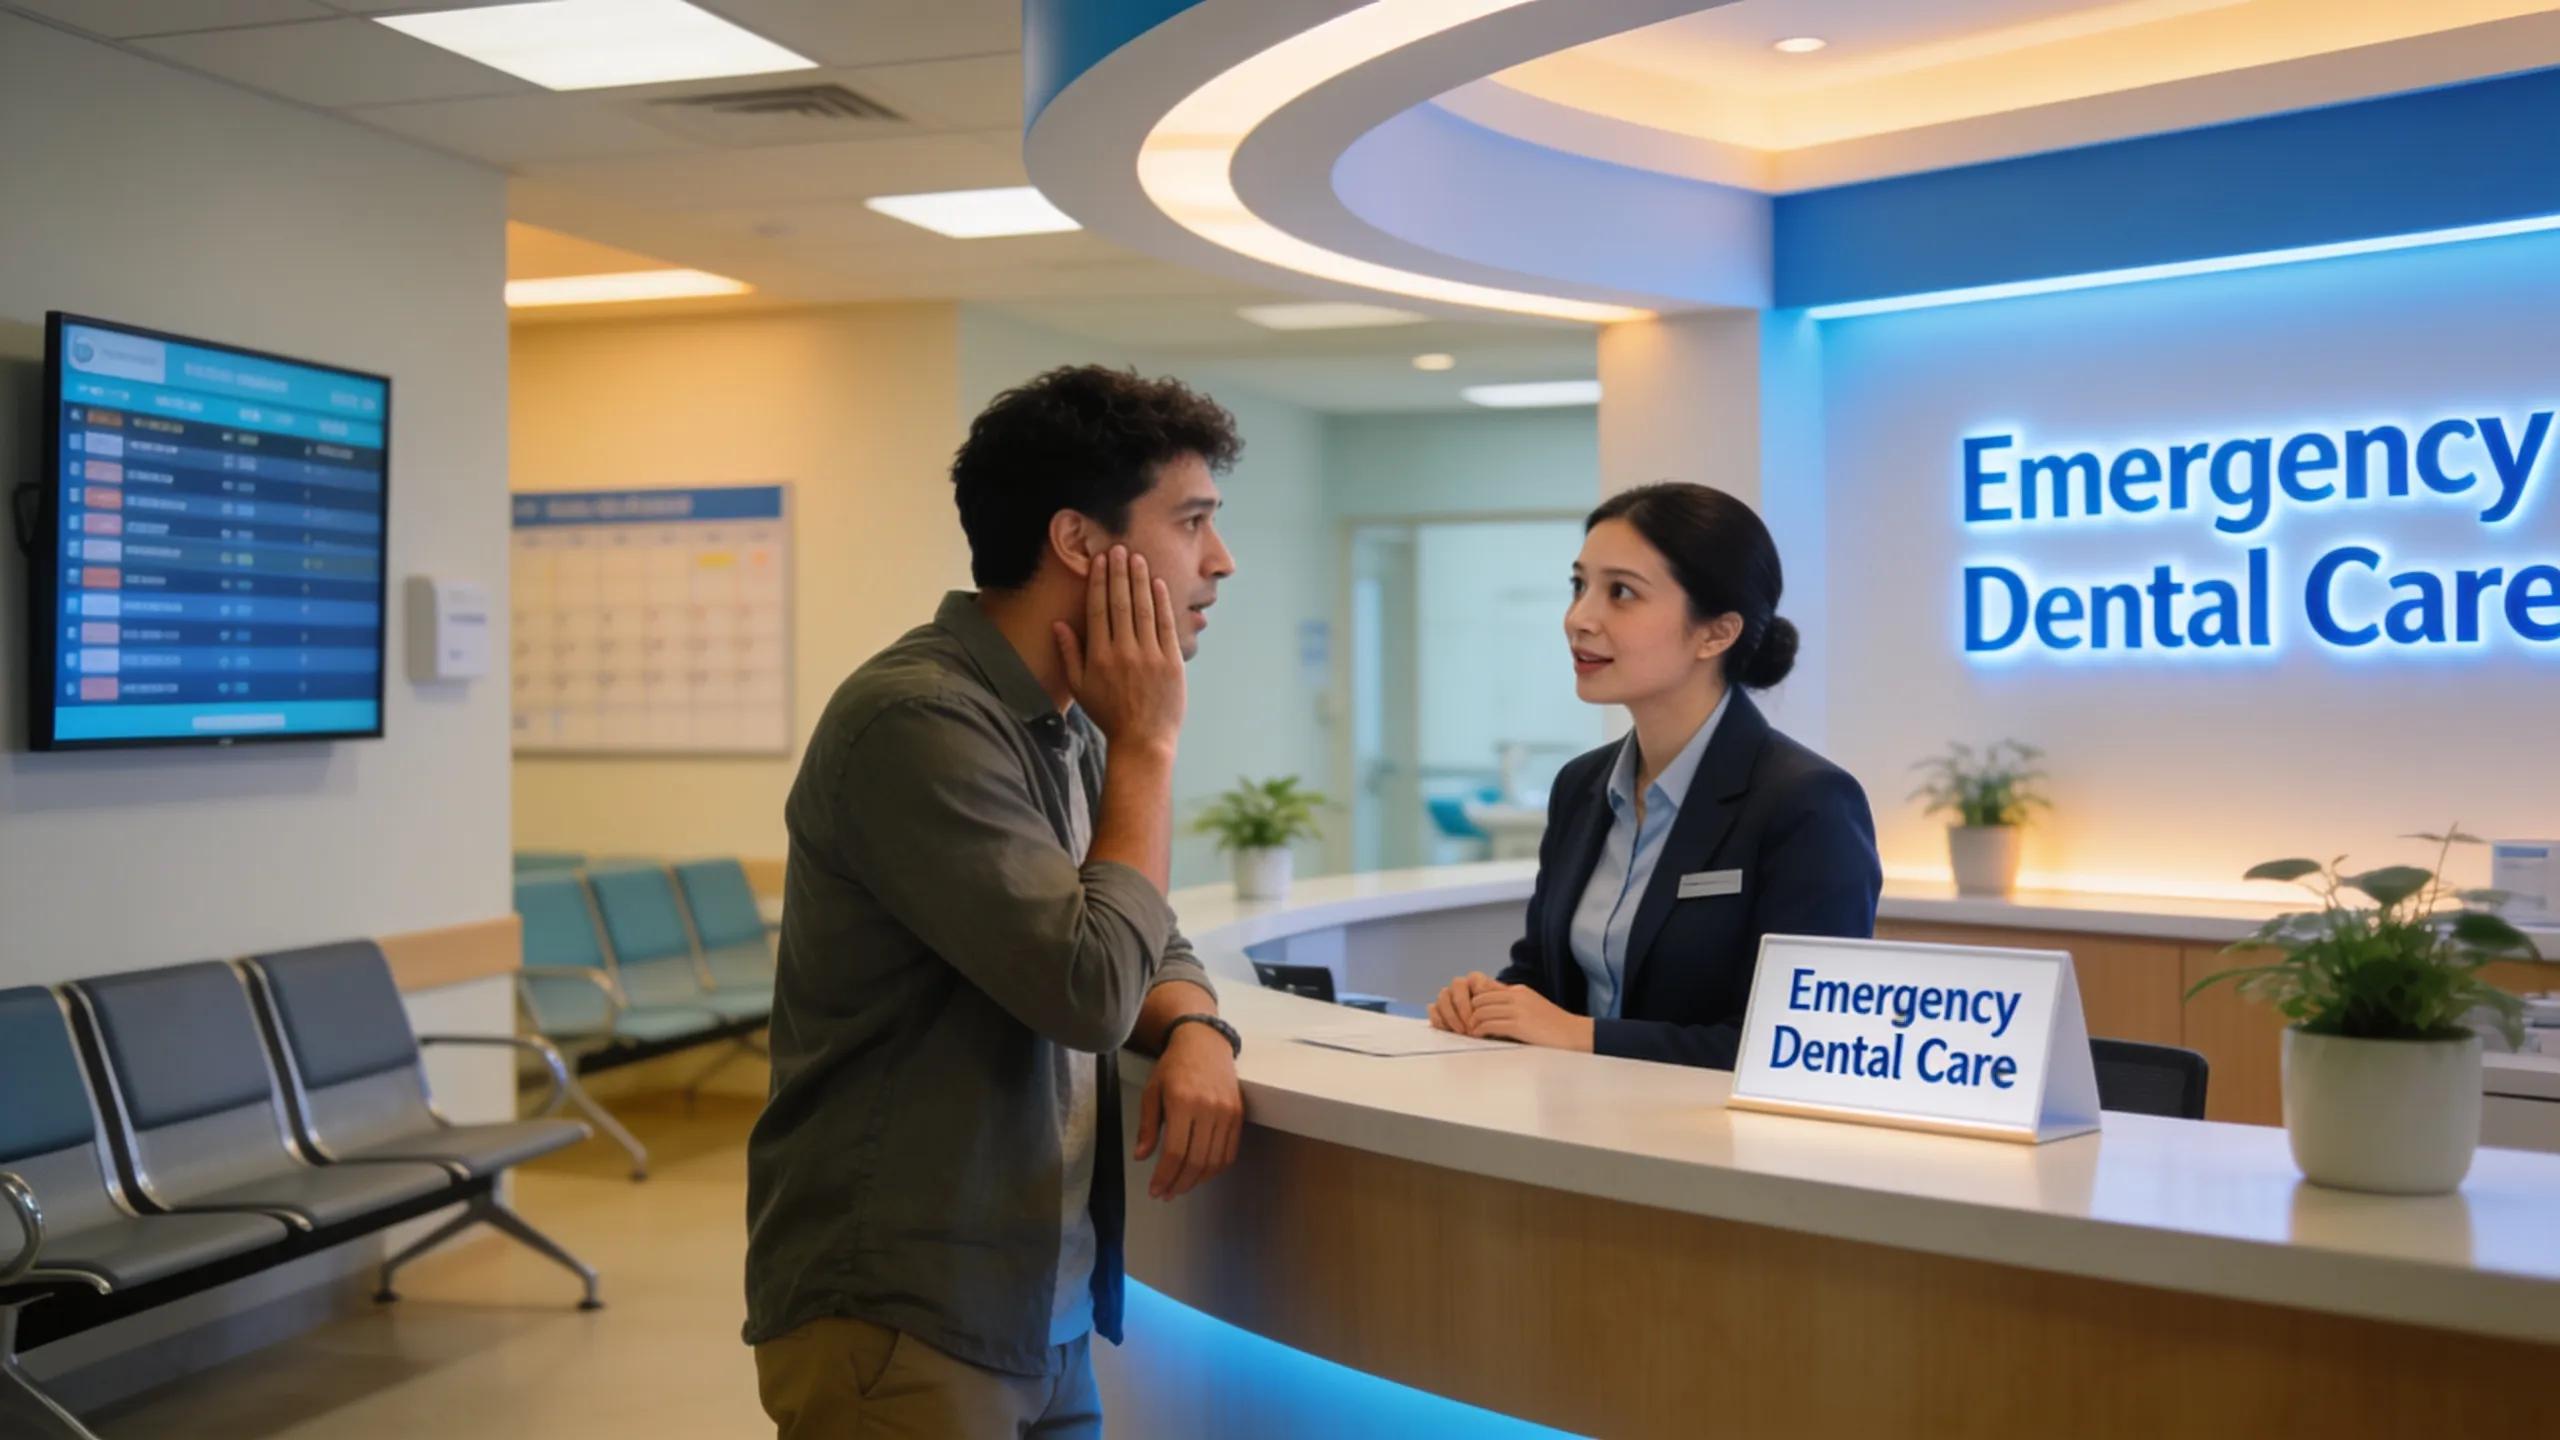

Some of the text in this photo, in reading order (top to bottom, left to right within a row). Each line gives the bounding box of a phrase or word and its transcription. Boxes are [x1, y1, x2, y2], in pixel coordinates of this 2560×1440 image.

[1962, 411, 2555, 534] Emergency
[1963, 546, 2560, 651] Dental Care
[1788, 968, 2022, 1038] Emergency
[1769, 1025, 2018, 1089] Dental Care
